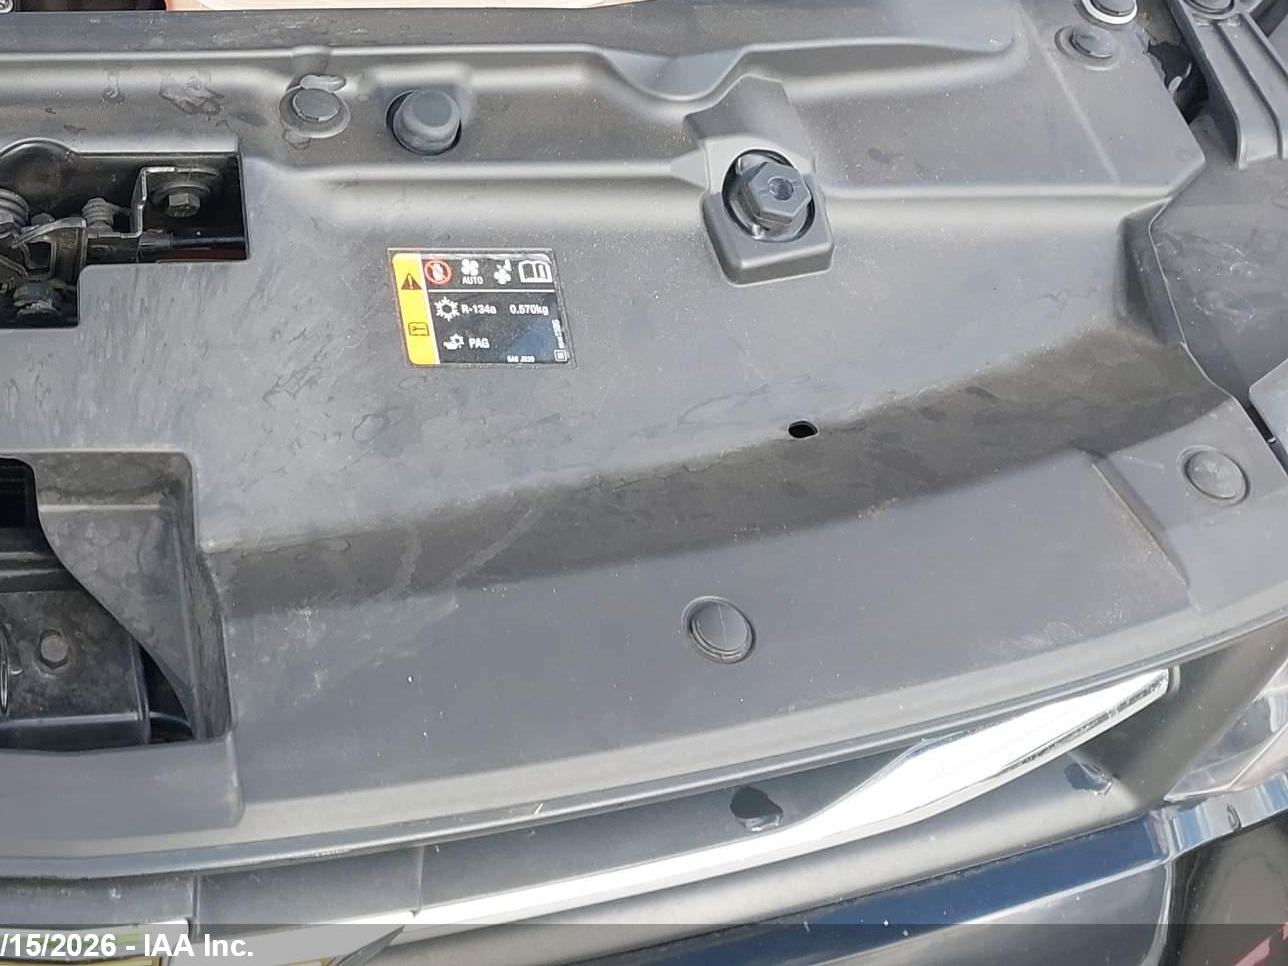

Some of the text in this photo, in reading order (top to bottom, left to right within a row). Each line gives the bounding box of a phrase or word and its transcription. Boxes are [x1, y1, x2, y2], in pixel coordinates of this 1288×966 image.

[462, 276, 483, 284] AUTO
[461, 304, 549, 316] R-134a 0.570kg
[468, 337, 490, 349] PAG
